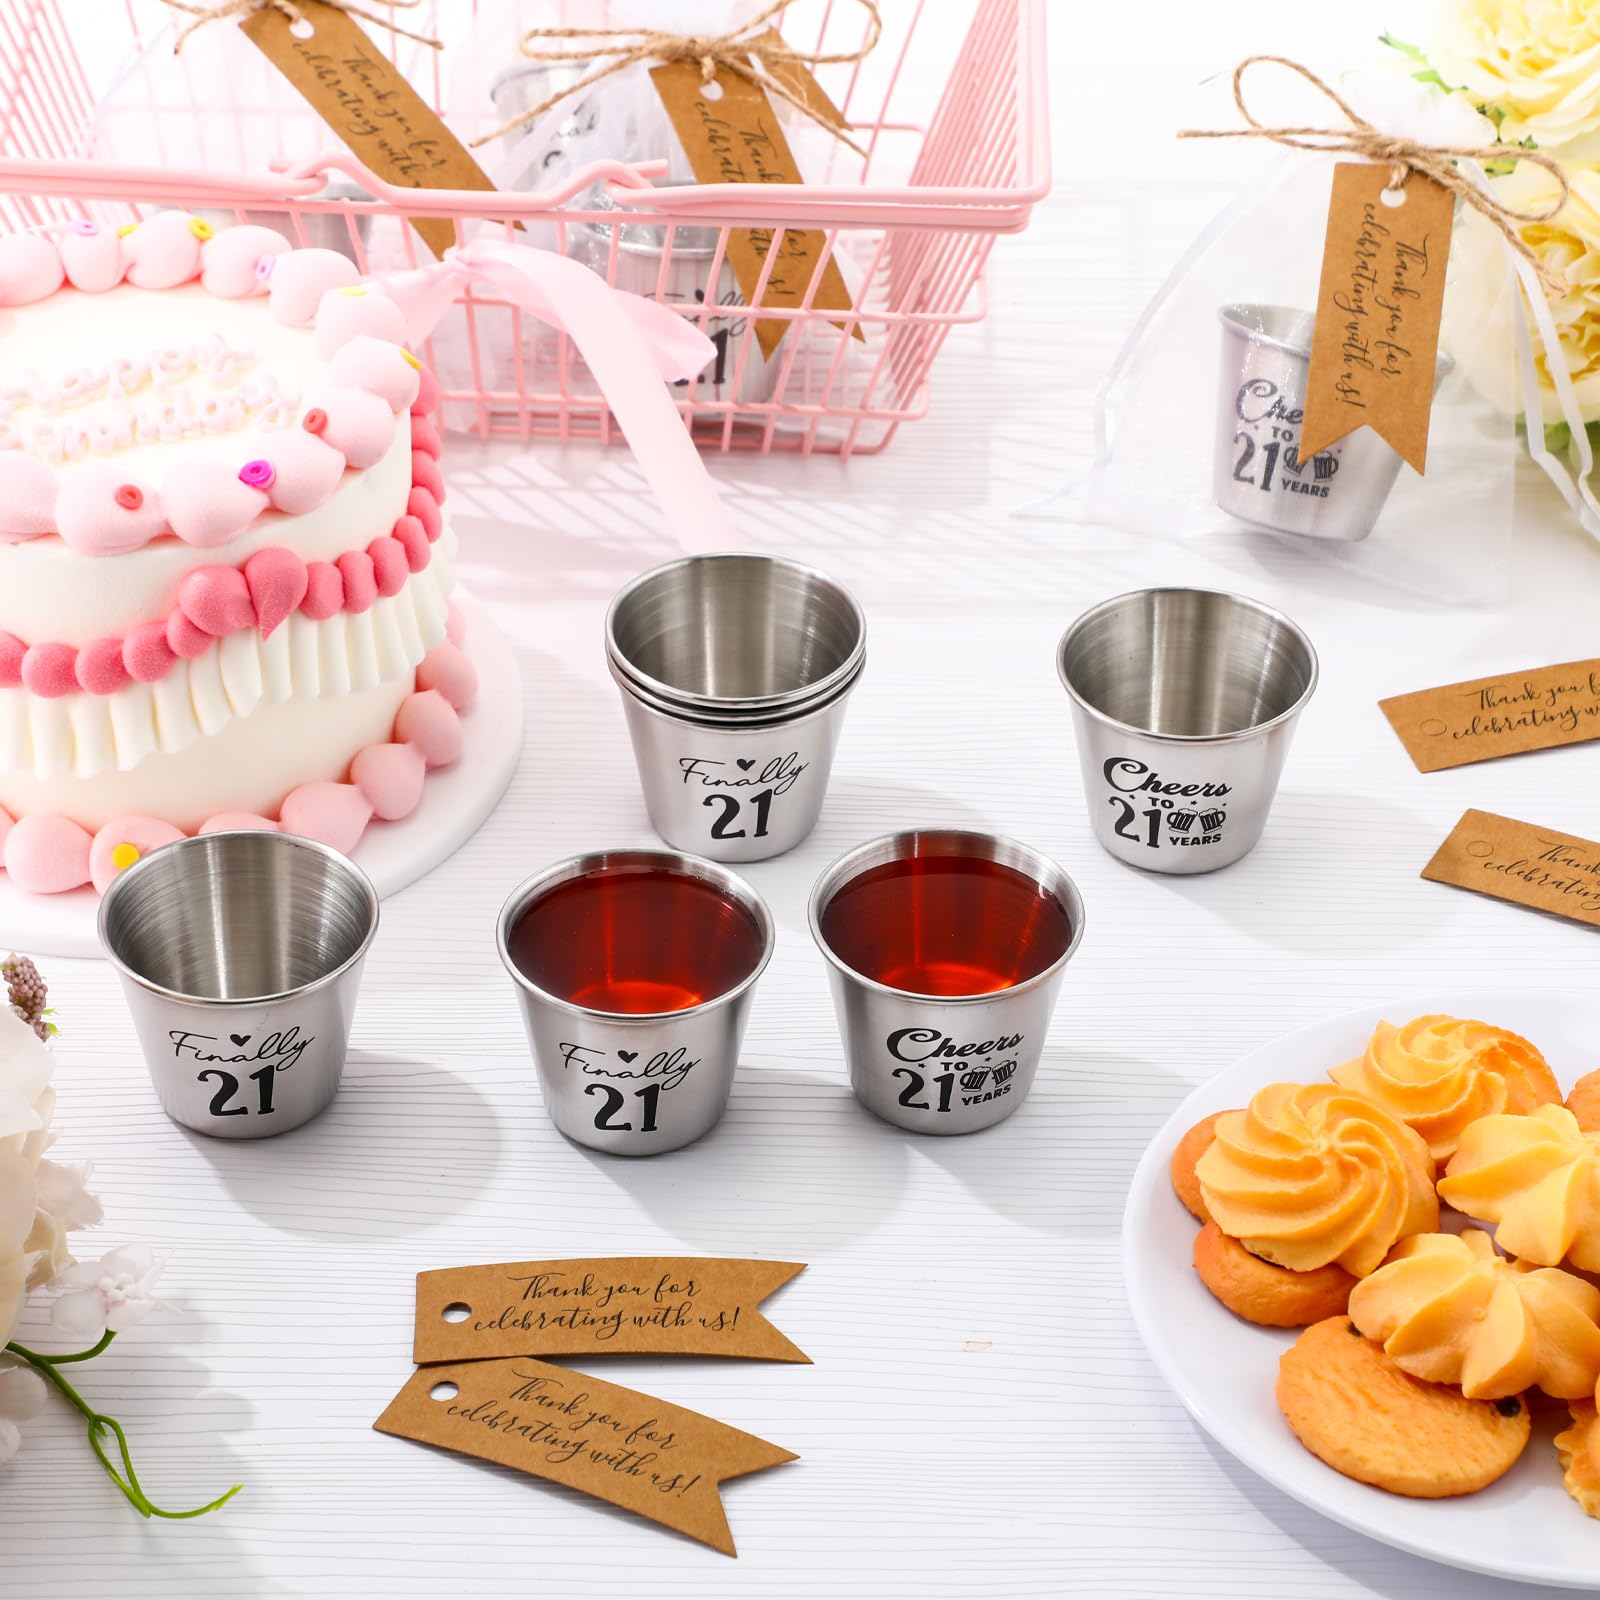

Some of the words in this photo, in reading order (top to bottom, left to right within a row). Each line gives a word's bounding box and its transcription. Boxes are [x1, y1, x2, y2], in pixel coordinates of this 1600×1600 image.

[342, 43, 399, 104] Thank
[373, 107, 413, 136] you
[408, 138, 448, 168] for
[694, 101, 746, 183] celebrat
[1333, 202, 1391, 319] celebrating
[1391, 232, 1431, 300] Thank
[1375, 296, 1403, 339] you
[1343, 321, 1375, 370] with
[1374, 340, 1411, 379] for
[1235, 378, 1304, 425] Che
[1335, 372, 1366, 408] us!
[1271, 425, 1294, 442] TO
[1232, 430, 1281, 492] 21
[1281, 478, 1331, 498] YEARS
[1457, 682, 1541, 711] Thank
[1544, 683, 1585, 708] you
[1452, 704, 1582, 740] celebrating
[679, 751, 810, 796] Finally
[1103, 756, 1233, 797] Cheers
[702, 788, 773, 840] 21
[1108, 796, 1162, 849] 21
[1169, 833, 1222, 846] YEARS
[1148, 796, 1175, 809] TO
[169, 1026, 316, 1072] Finally
[559, 1042, 702, 1091] Finally
[886, 1027, 1025, 1063] Cheers
[940, 1061, 969, 1071] TO
[197, 1064, 275, 1117] 21
[584, 1083, 661, 1132] 21
[891, 1067, 955, 1113] 21
[961, 1084, 1012, 1106] YEARS
[506, 1272, 599, 1301] Thank
[595, 1284, 650, 1308] you
[654, 1273, 702, 1303] for
[474, 1305, 628, 1341] celebrating
[632, 1301, 693, 1328] with
[698, 1306, 740, 1332] us!
[509, 1368, 590, 1416] Thank
[568, 1410, 630, 1432] you
[625, 1418, 680, 1450] for
[447, 1399, 589, 1464] celebrating
[589, 1447, 658, 1477] with
[651, 1472, 701, 1499] us!
